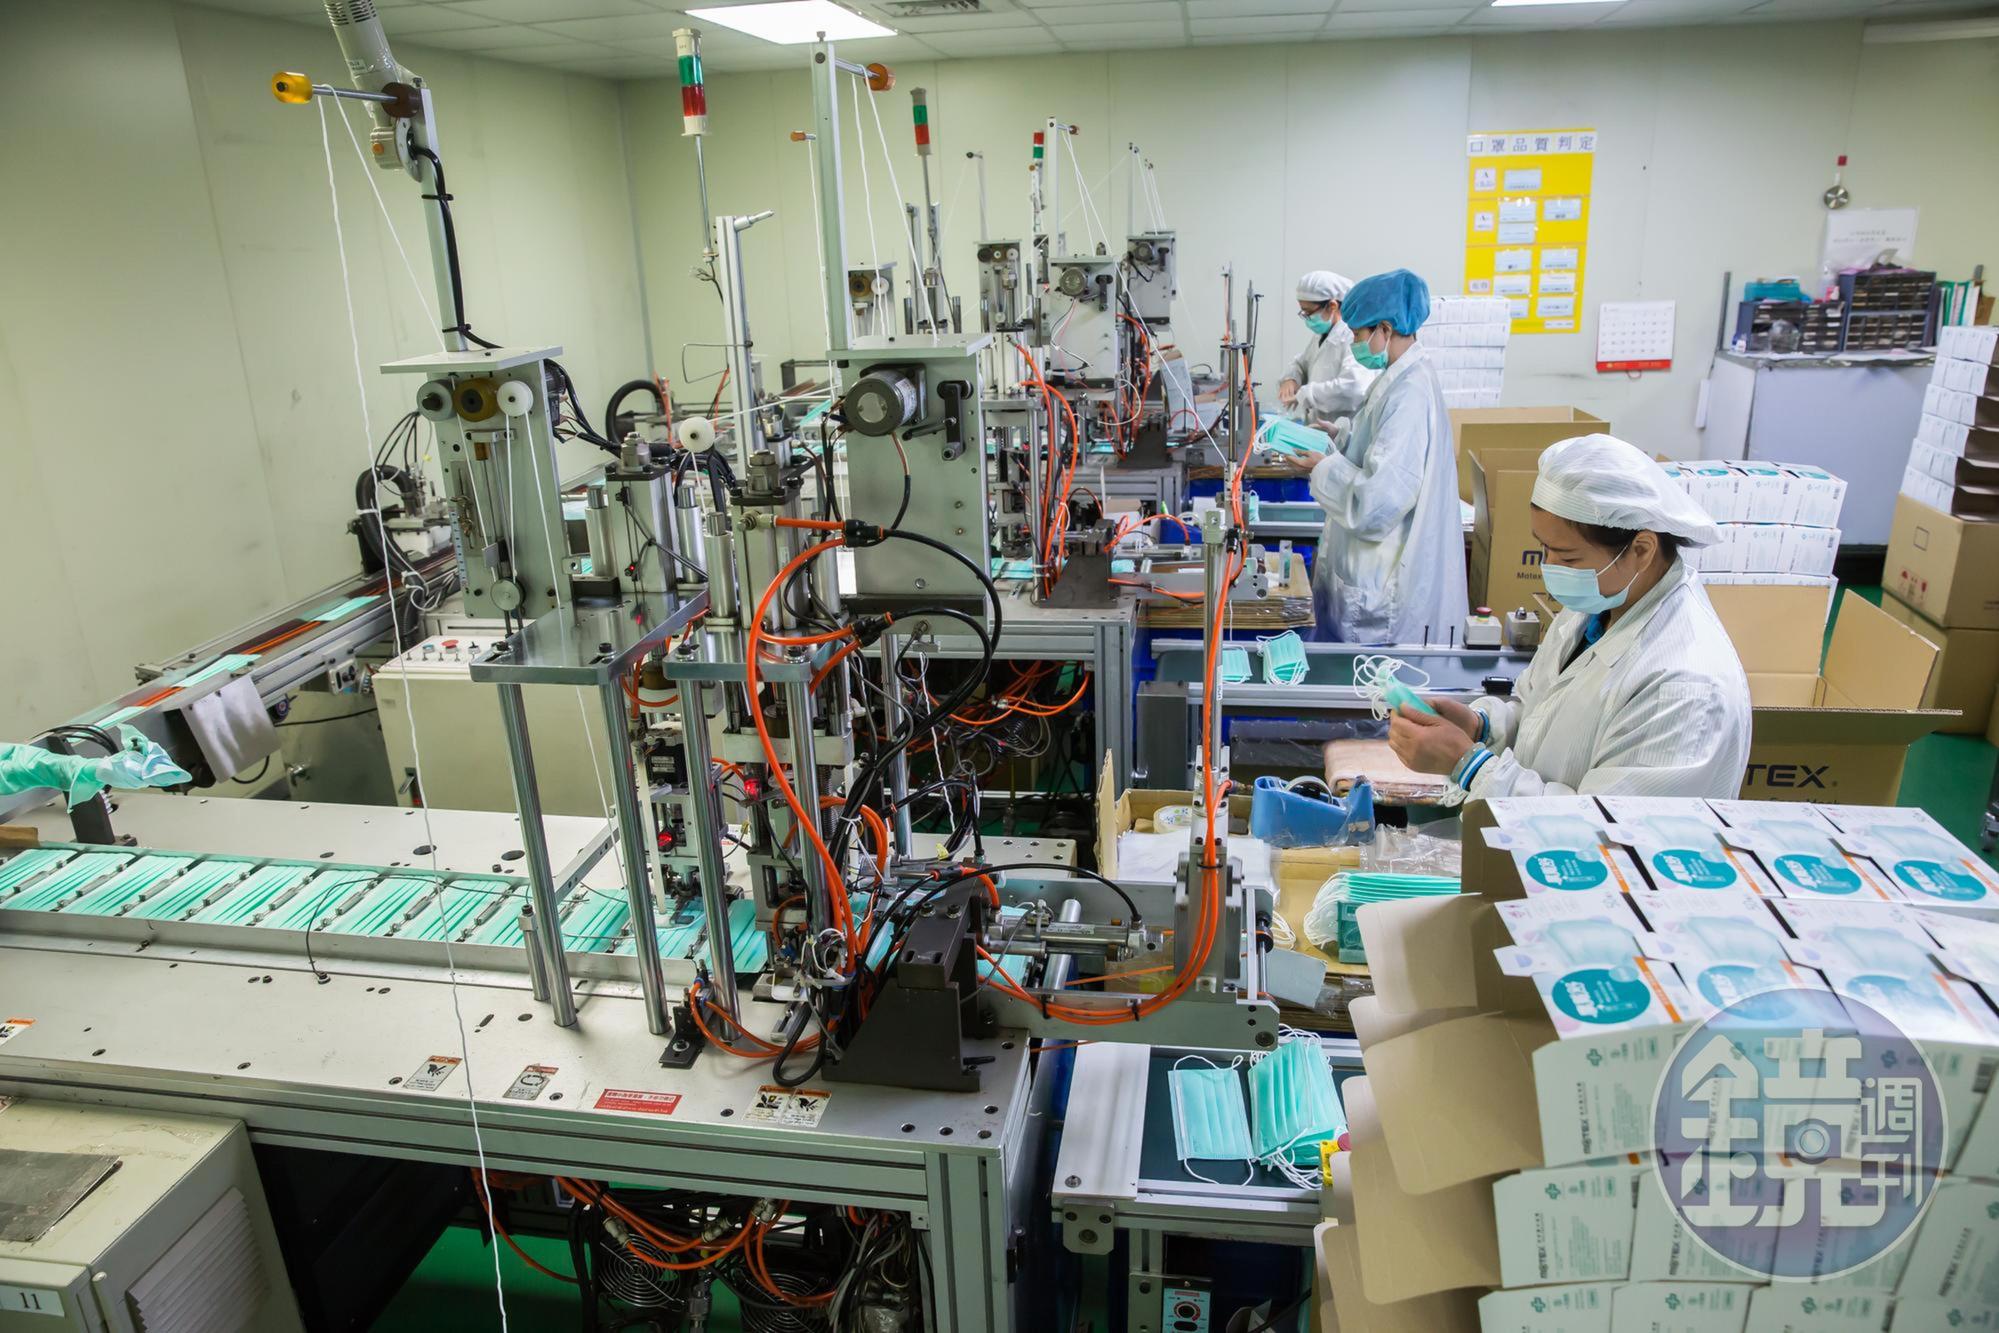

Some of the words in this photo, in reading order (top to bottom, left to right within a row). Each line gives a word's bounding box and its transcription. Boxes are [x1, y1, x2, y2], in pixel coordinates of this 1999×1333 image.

[1470, 136, 1594, 153] 口罩品質判定
[1747, 764, 1829, 788] TEX
[19, 1292, 42, 1310] 11
